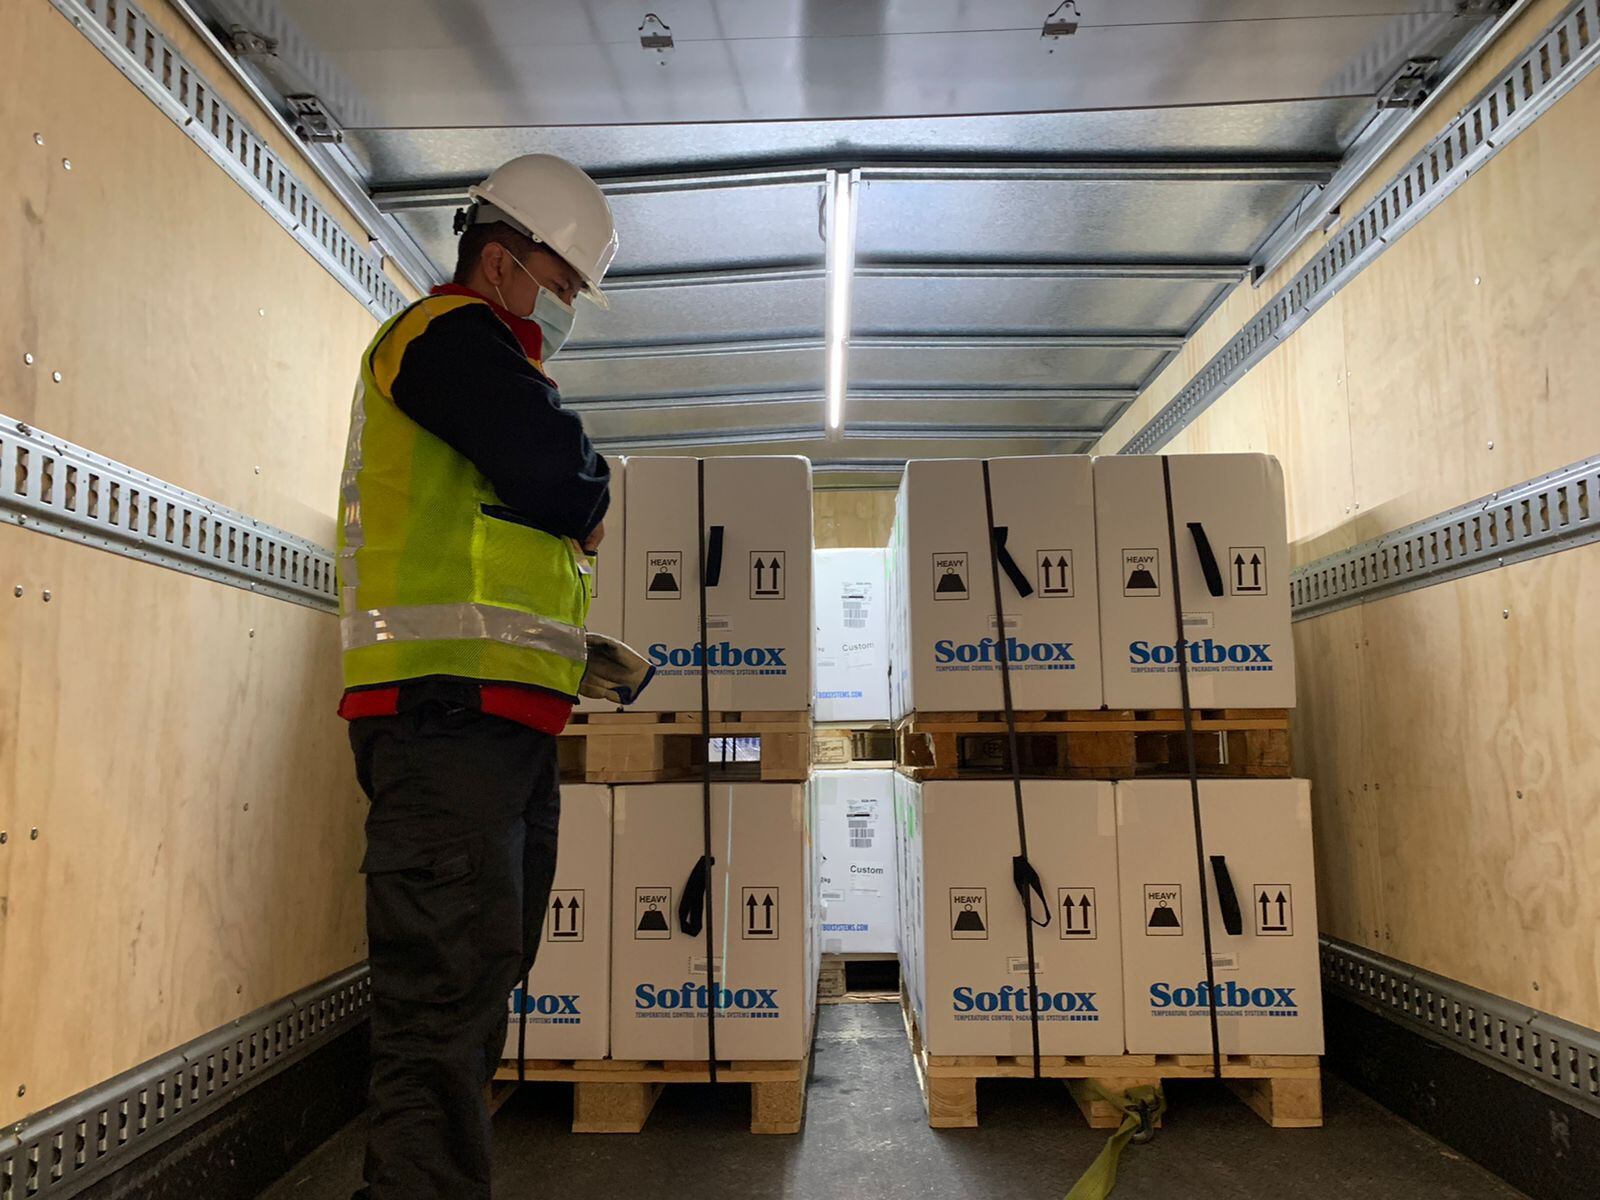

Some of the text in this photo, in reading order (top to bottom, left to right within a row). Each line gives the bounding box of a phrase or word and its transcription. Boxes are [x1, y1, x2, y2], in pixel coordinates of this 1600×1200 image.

[650, 559, 678, 567] HEAVY
[936, 560, 964, 568] HEAVY
[1126, 556, 1154, 564] HEAVY
[648, 641, 787, 668] Softbox
[934, 637, 1076, 664] Softbox
[850, 864, 884, 874] Custom
[639, 895, 668, 904] HEAVY
[954, 896, 982, 904] HEAVY
[1148, 892, 1177, 900] HEAVY
[635, 981, 779, 1010] Softbox
[953, 985, 1099, 1012] Softbox
[1150, 980, 1298, 1008] Softbox
